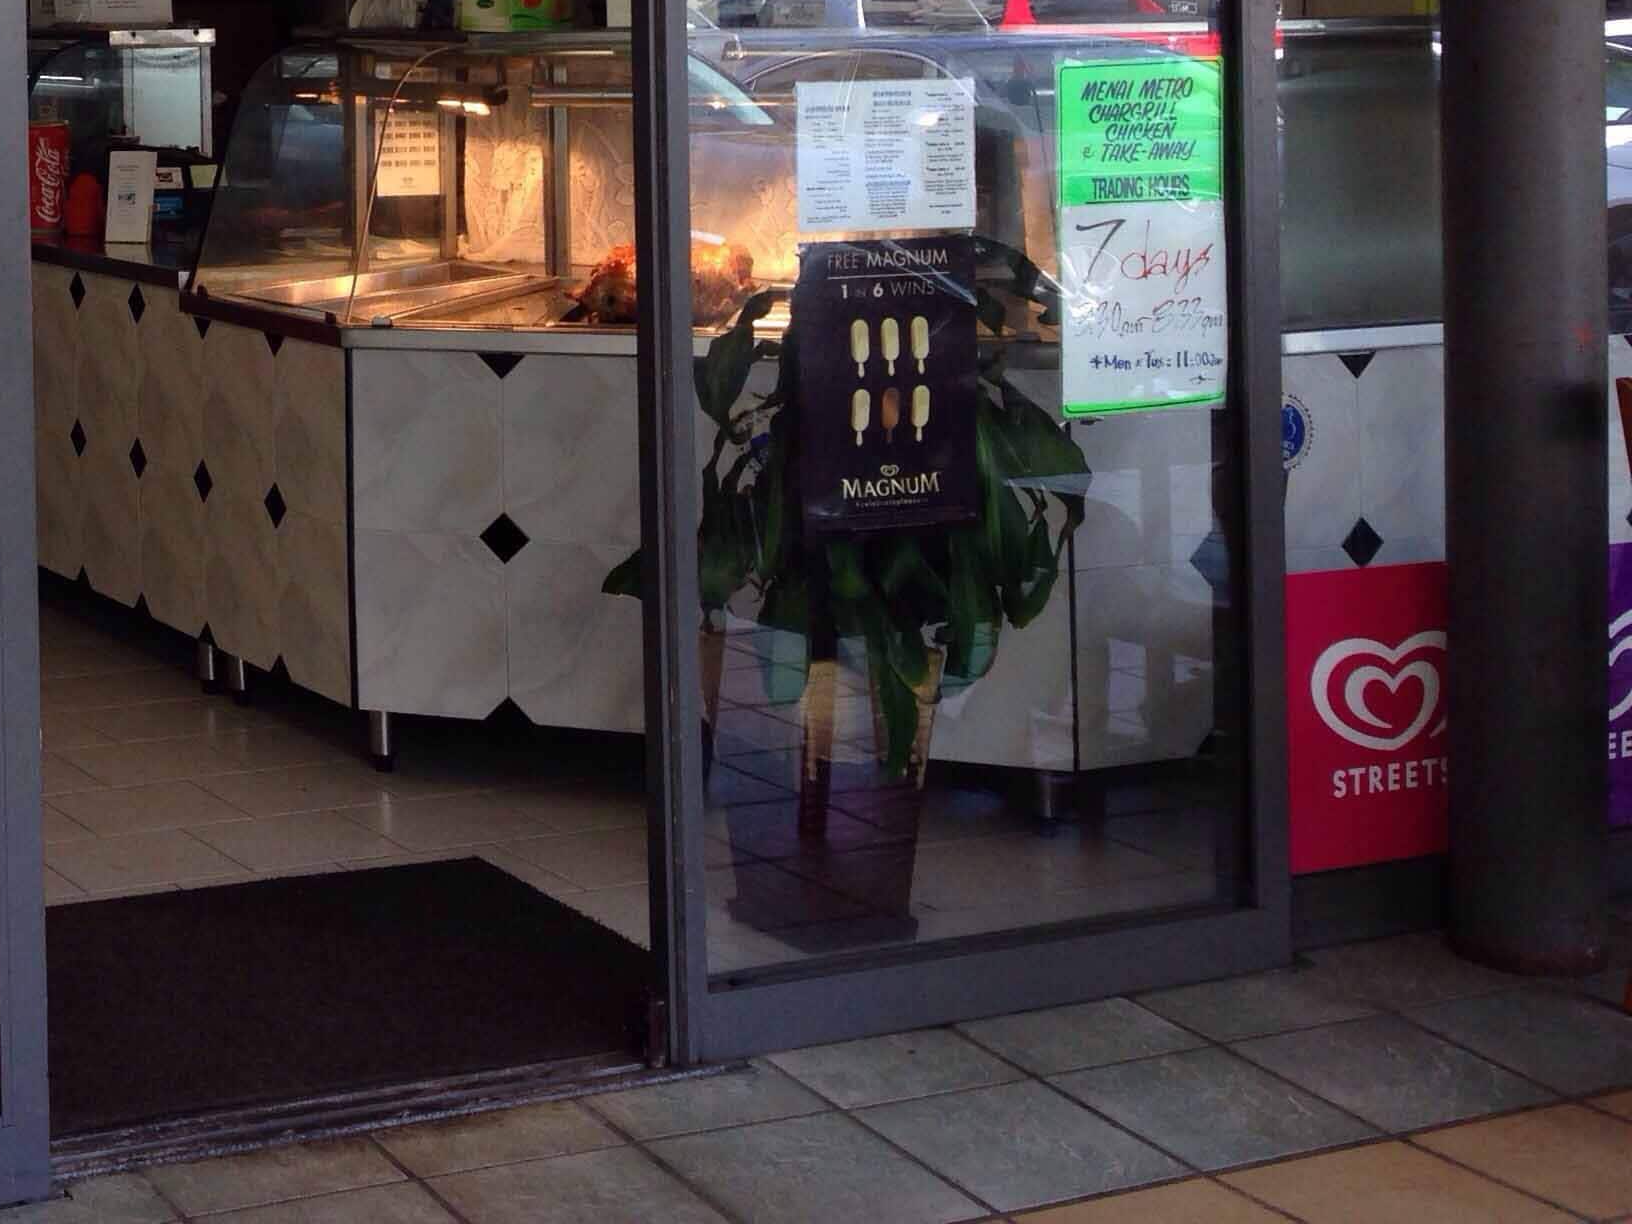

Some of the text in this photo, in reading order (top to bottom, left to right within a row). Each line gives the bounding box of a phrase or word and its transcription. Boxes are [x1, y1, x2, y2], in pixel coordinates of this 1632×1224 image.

[1081, 77, 1194, 101] MENAI METRO
[1089, 101, 1177, 123] CHARGRILL
[1105, 122, 1177, 142] CHICKEN
[1092, 175, 1191, 200] TRADING HOURS
[828, 248, 949, 270] FREE MAGNUM
[1075, 218, 1214, 295] 7 days
[841, 283, 849, 299] 1
[872, 283, 885, 298] 6
[890, 281, 936, 297] WINS
[841, 472, 941, 499] MAGNUM
